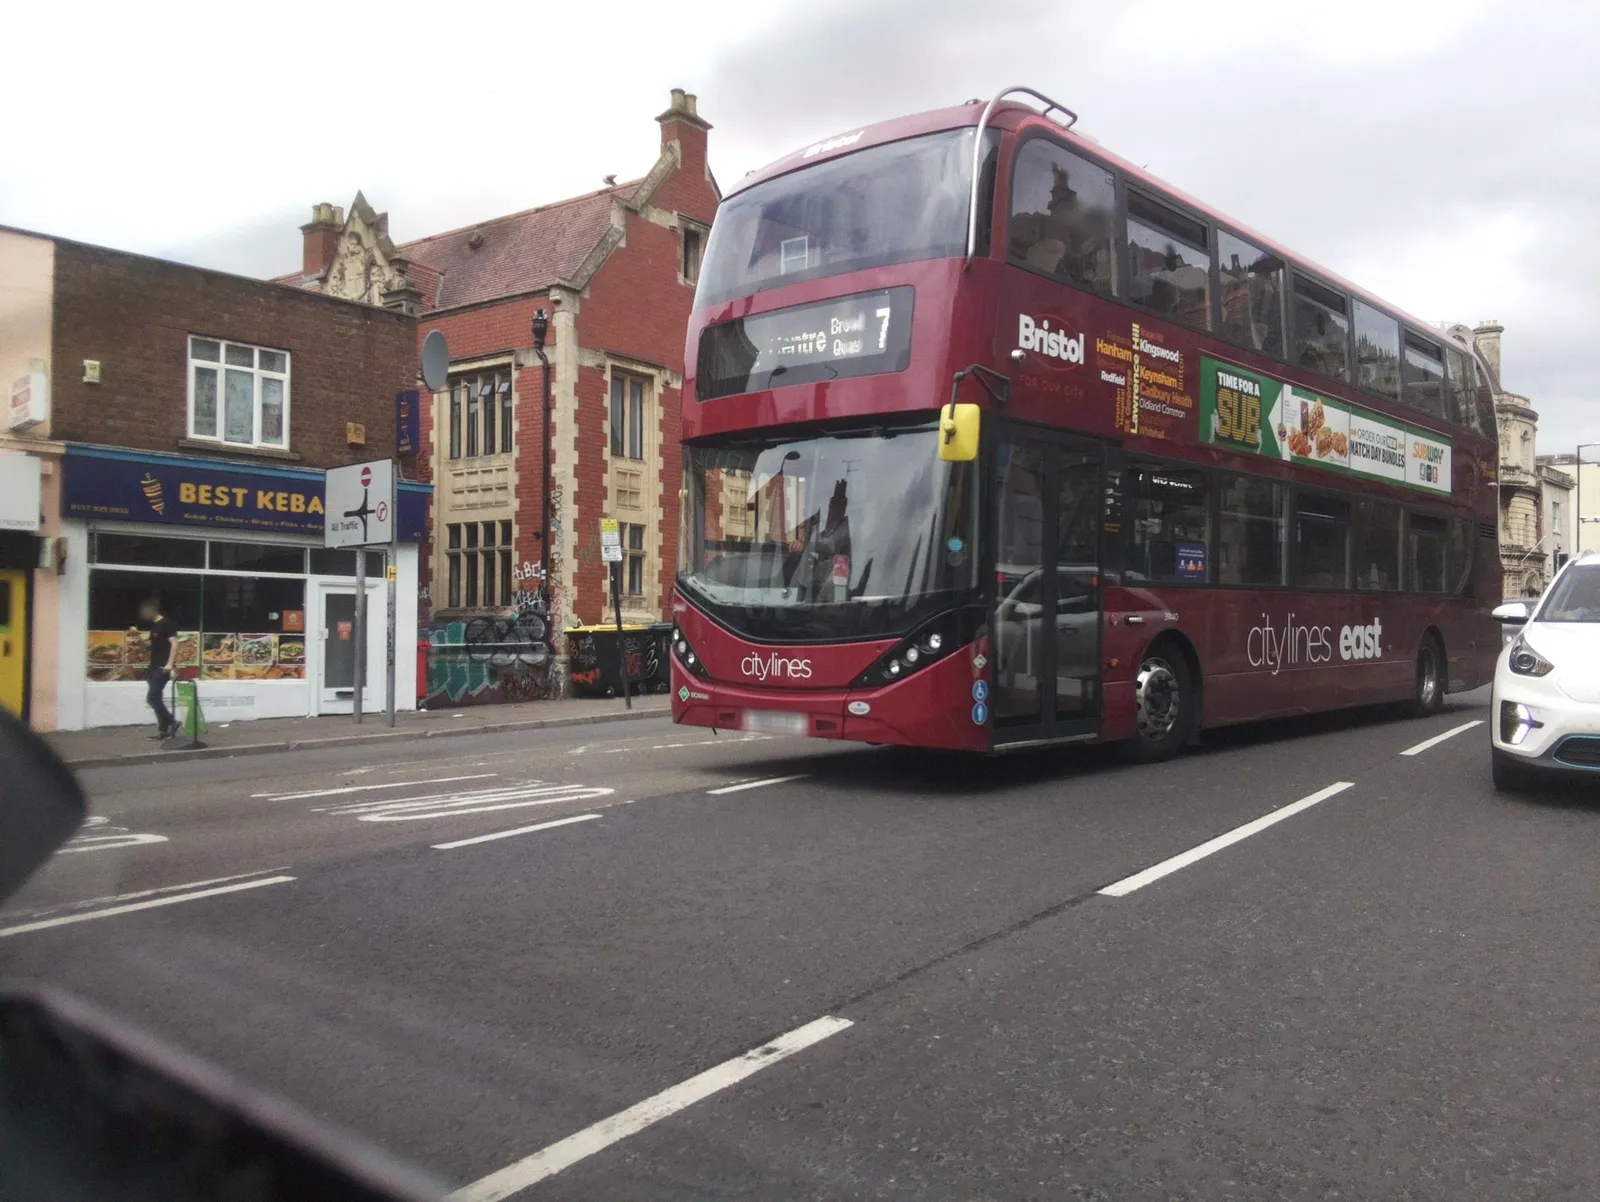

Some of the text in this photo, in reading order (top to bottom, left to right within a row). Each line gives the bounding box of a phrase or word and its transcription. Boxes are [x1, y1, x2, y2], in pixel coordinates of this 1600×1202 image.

[876, 307, 891, 349] 7
[1018, 313, 1085, 365] Bristol
[1096, 337, 1132, 362] Hanham
[1140, 338, 1179, 363] Kingswood
[1101, 370, 1126, 386] Redfield
[1130, 322, 1140, 434] Lawrence Hill
[1139, 365, 1178, 389] Keynsham
[1217, 371, 1261, 397] TIME FOR A
[1140, 382, 1193, 408] Cadbury Heath
[1139, 398, 1161, 413] Oldland
[1161, 403, 1186, 419] Common
[1217, 388, 1260, 444] SUB
[1357, 428, 1375, 443] ORDER
[1370, 445, 1381, 462] DAY
[1381, 448, 1405, 468] BUNDLES
[1413, 441, 1444, 465] SUBWAY
[179, 482, 325, 515] BEST KEBA
[331, 521, 358, 532] All Traffic
[1247, 612, 1382, 675] citylines east
[741, 651, 812, 681] citylines
